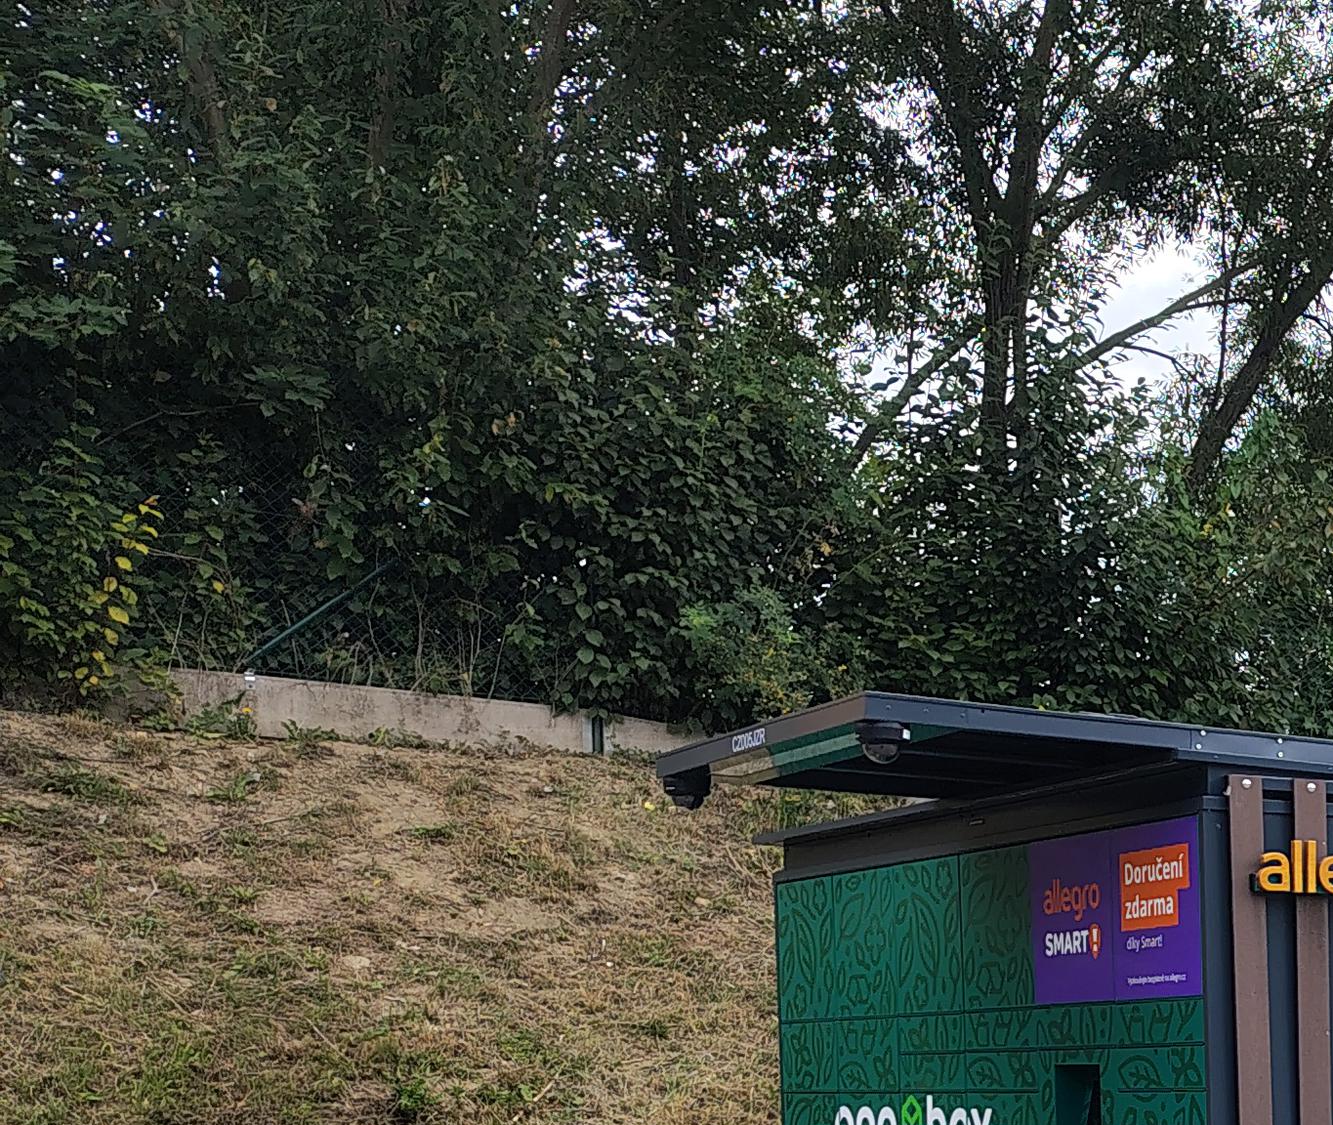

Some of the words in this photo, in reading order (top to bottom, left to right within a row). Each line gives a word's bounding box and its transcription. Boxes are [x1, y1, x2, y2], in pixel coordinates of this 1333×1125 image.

[1124, 853, 1184, 886] Doručení
[1043, 879, 1100, 921] allegro
[1125, 894, 1173, 919] zdarma
